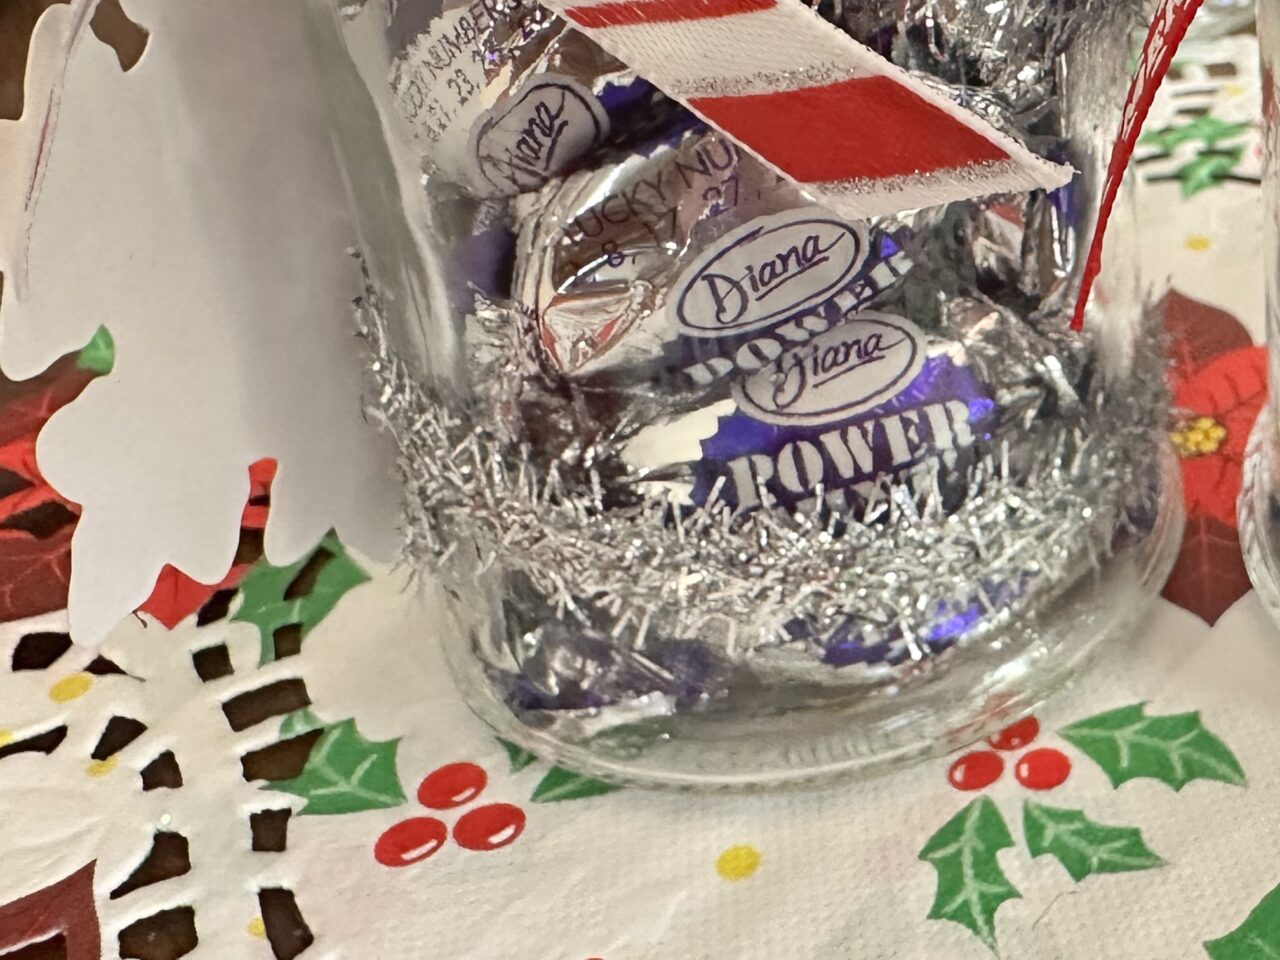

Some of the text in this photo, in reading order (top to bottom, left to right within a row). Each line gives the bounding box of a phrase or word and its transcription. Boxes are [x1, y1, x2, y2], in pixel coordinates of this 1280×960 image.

[701, 231, 847, 324] Diana
[770, 331, 907, 410] Diana
[727, 400, 976, 515] POWER
